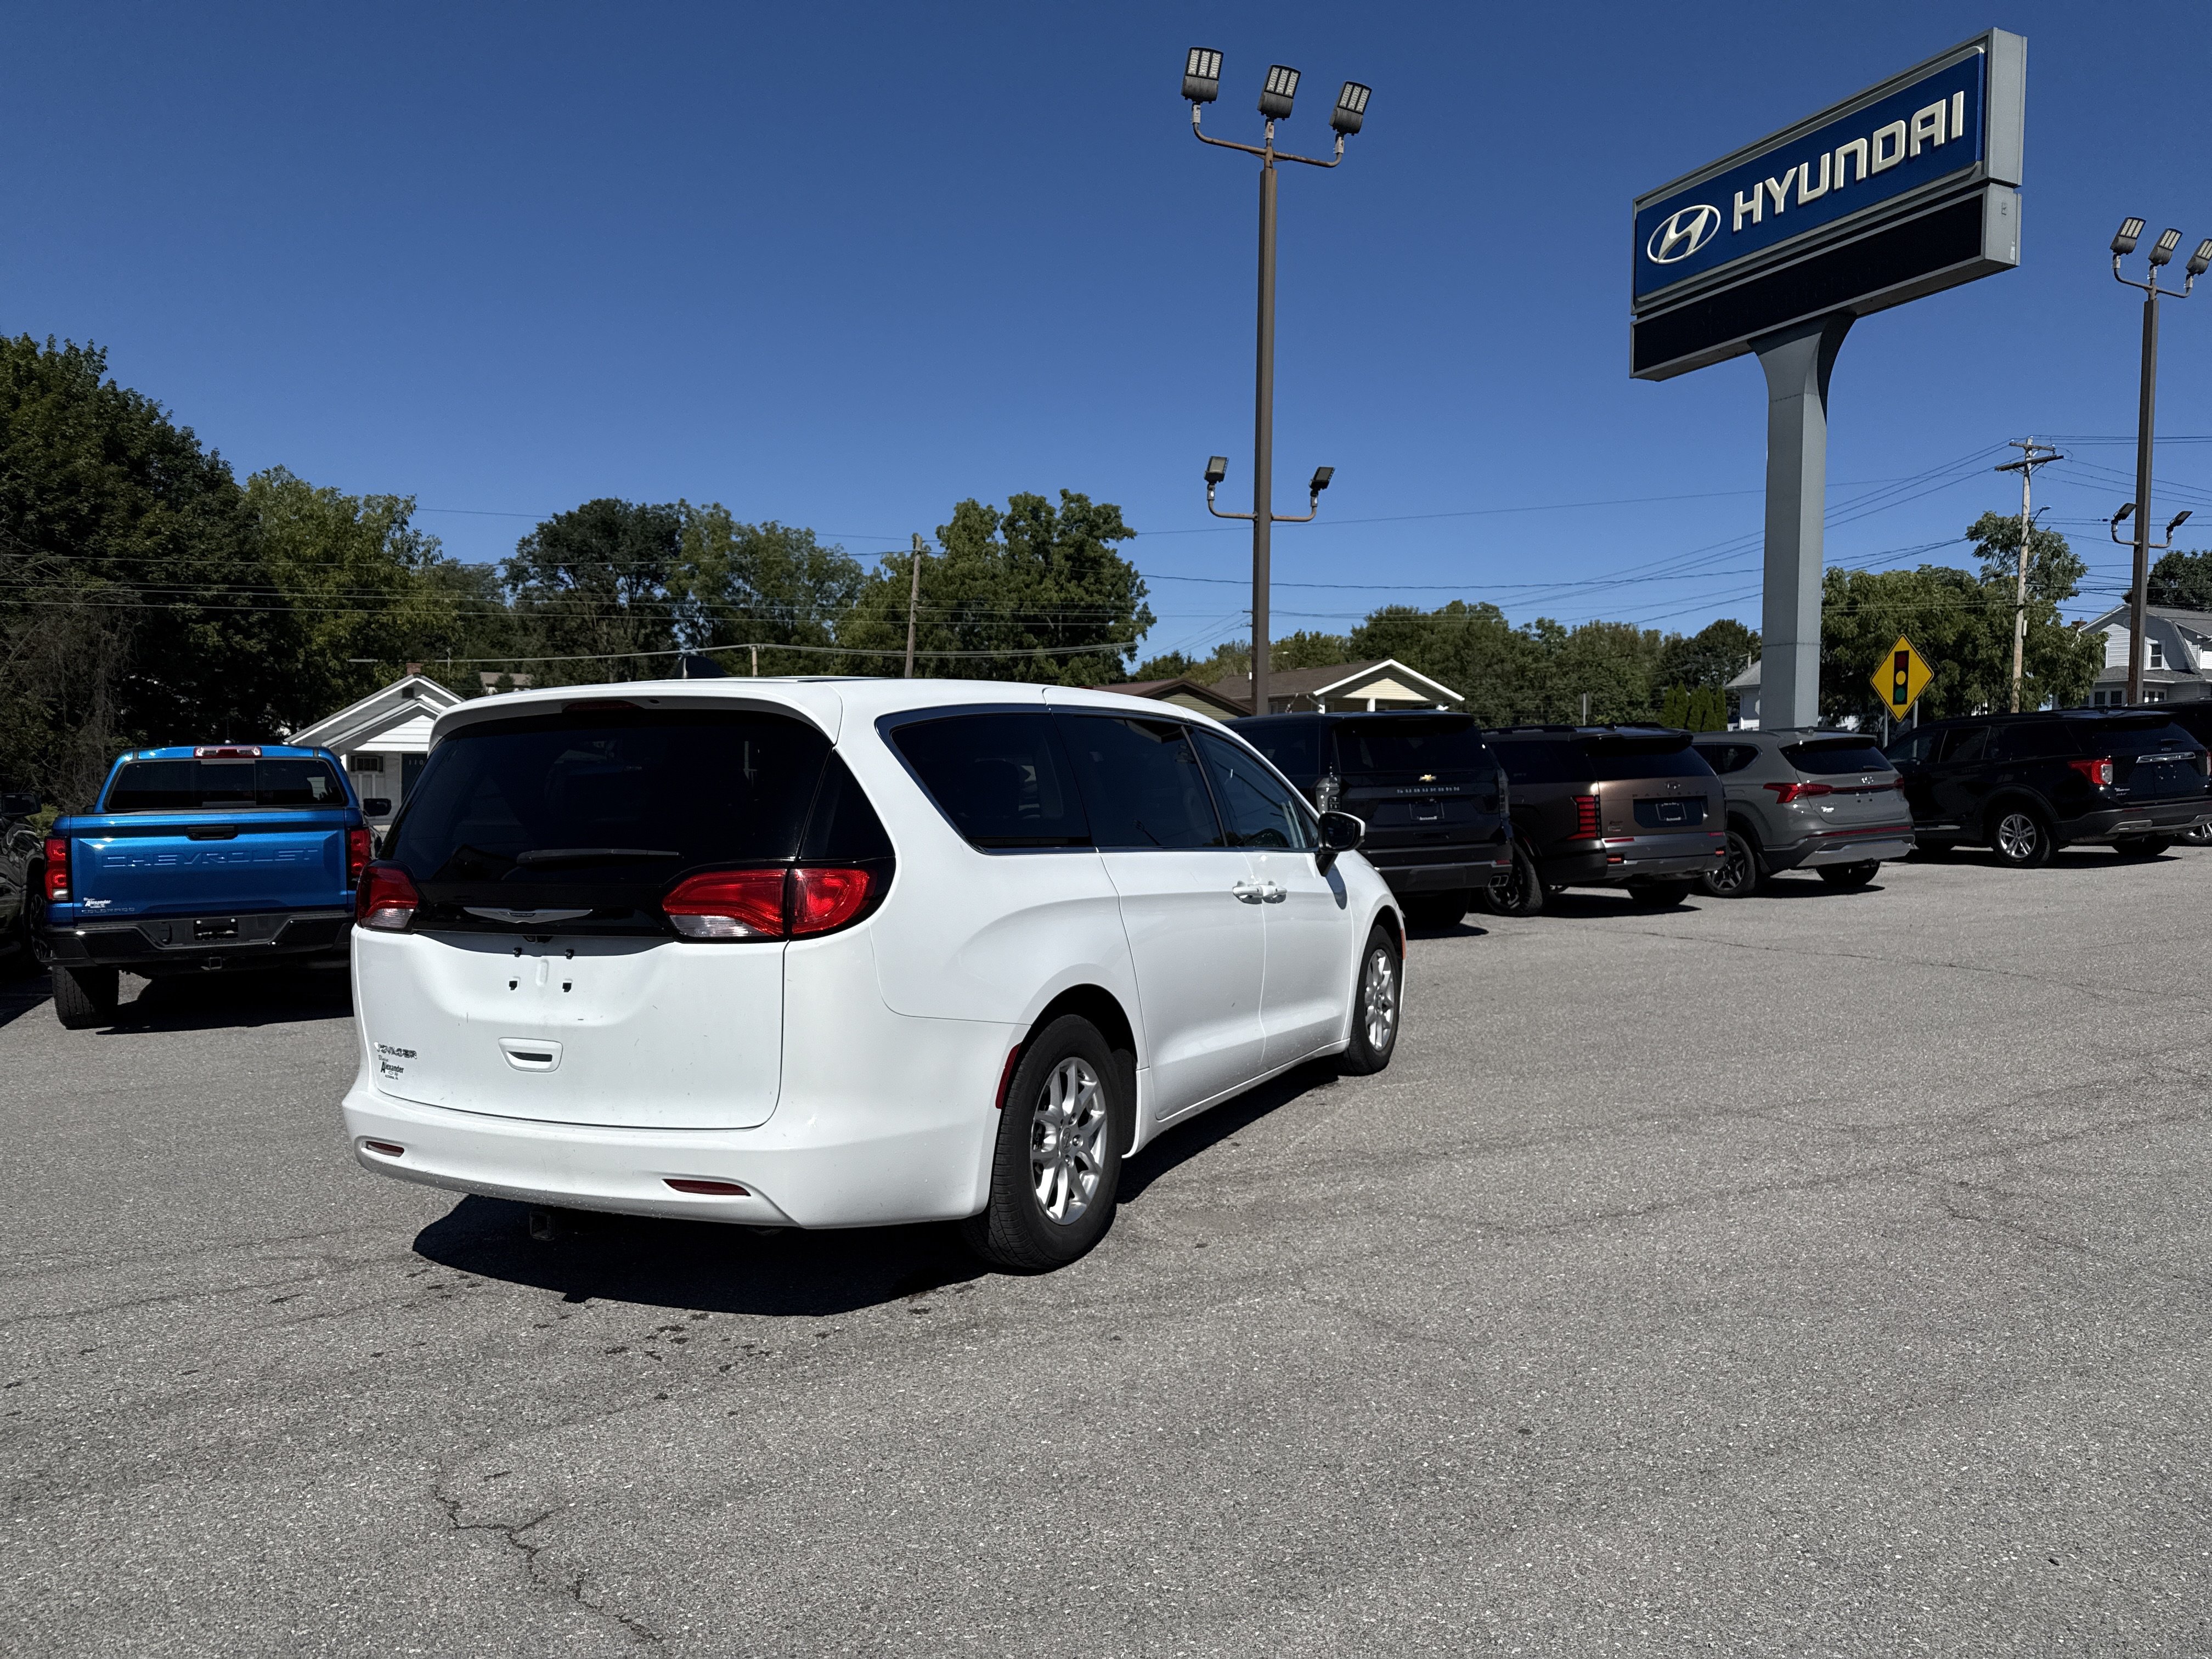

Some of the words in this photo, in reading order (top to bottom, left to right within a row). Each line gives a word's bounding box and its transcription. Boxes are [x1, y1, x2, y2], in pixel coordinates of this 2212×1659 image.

[1732, 90, 1965, 233] HYUNDAI
[101, 847, 319, 867] CHEVROLET
[374, 1042, 417, 1060] VOYAGER
[380, 1061, 404, 1074] Alexander
